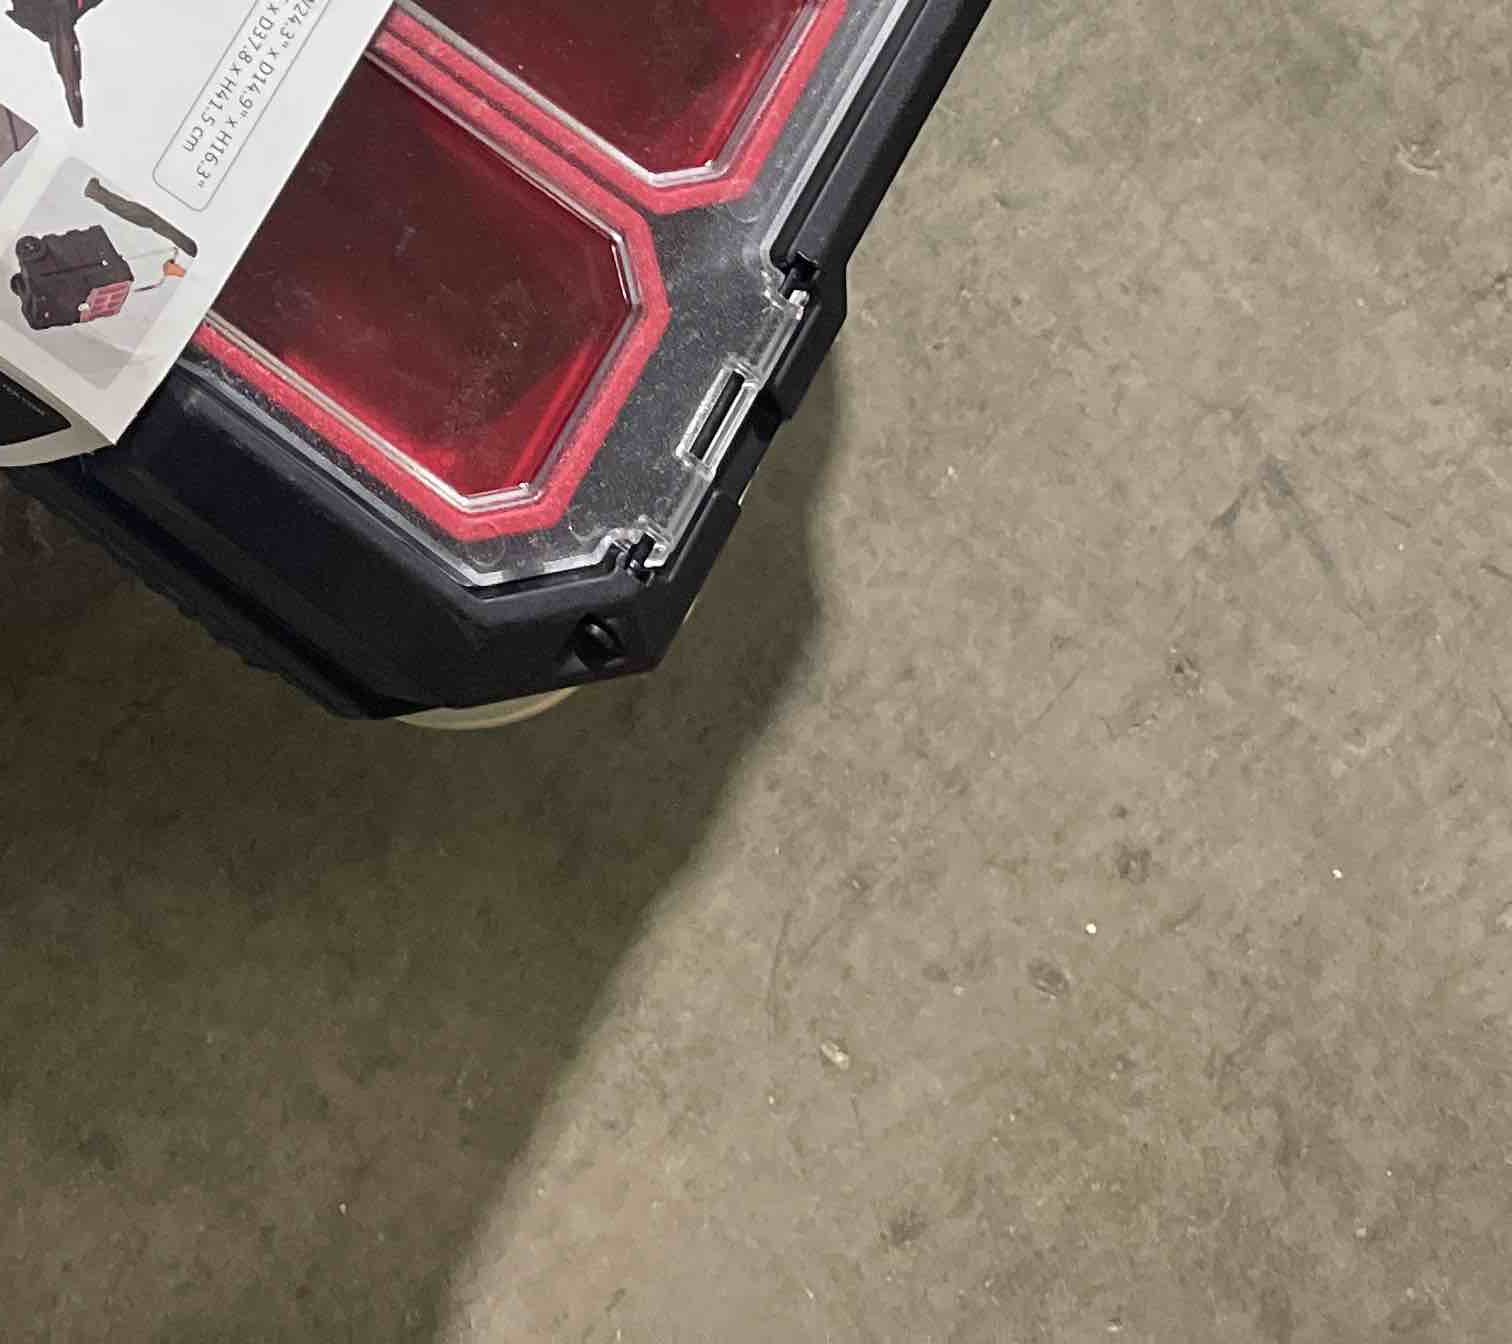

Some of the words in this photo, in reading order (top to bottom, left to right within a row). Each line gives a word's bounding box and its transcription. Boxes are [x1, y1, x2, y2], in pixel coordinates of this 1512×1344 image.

[236, 15, 273, 65] D37.8
[199, 76, 236, 125] H41.5
[181, 124, 205, 153] cm
